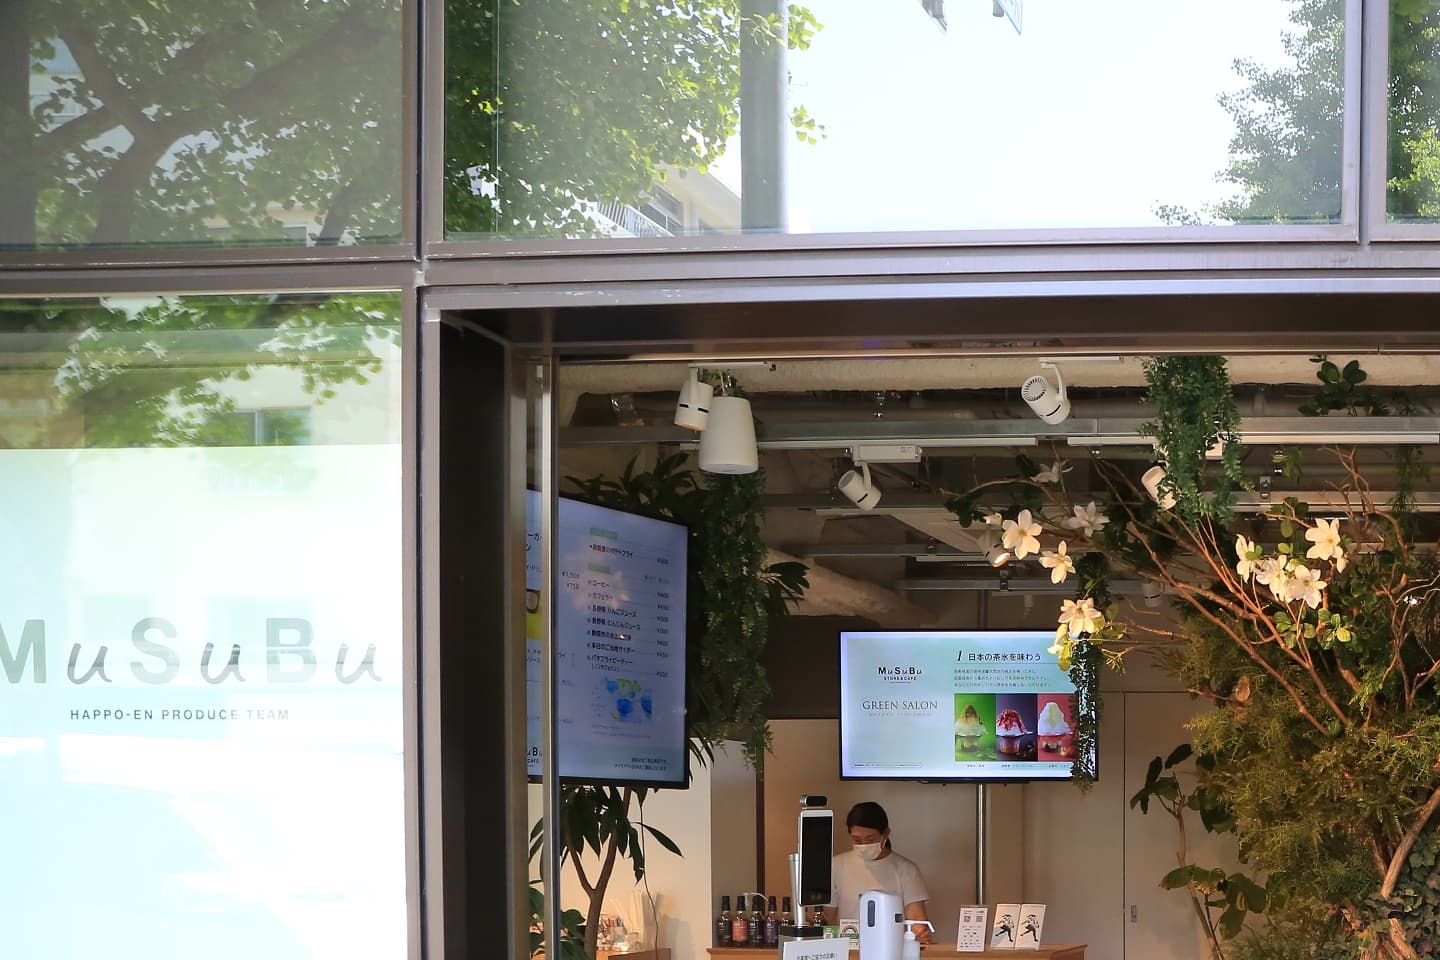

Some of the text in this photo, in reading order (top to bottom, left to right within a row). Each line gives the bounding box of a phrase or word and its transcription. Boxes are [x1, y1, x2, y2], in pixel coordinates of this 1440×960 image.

[0, 617, 382, 685] MuSuBu
[878, 667, 922, 675] MuSuBu
[862, 700, 938, 710] GREEN SALON
[70, 709, 290, 721] HAPPO-EN PRODUCE TEAM
